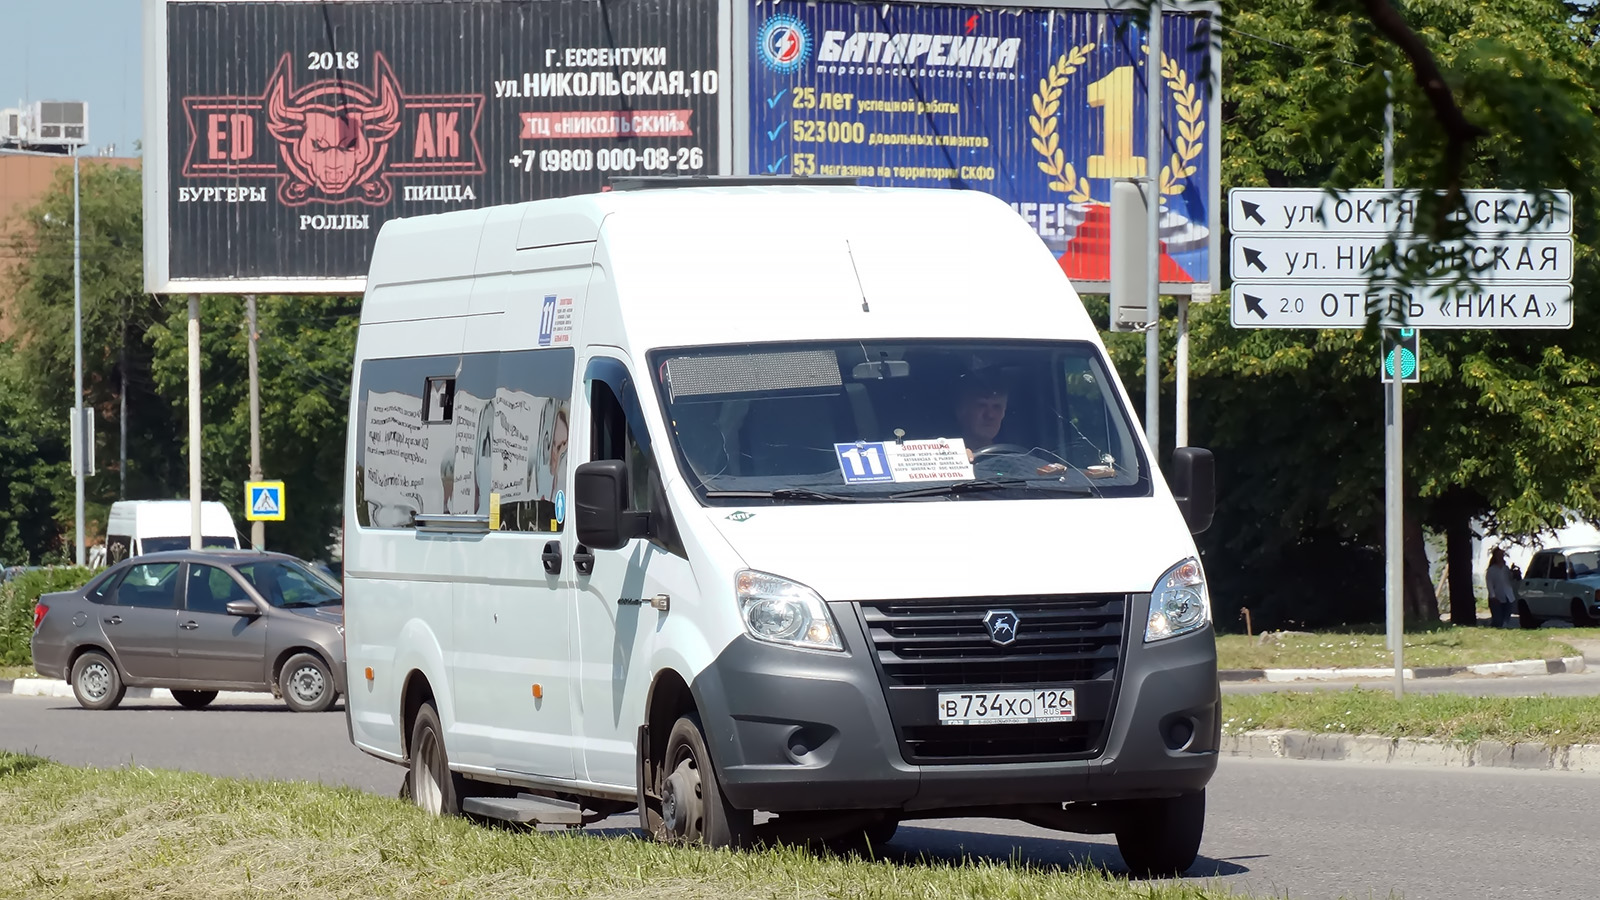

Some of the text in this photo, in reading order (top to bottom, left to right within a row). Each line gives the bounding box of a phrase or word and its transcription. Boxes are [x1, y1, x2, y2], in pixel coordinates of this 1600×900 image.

[308, 52, 360, 70] 2018
[565, 47, 667, 67] ЕССЕНТУКИ
[817, 64, 1016, 80] торгово-сервисная сеть
[792, 87, 959, 115] 25 лет успешной работы
[526, 112, 685, 136] ТЦ «НИКОЛЬСКИЙ»
[793, 120, 989, 148] 523000 довольных клиентов
[1087, 66, 1148, 178] 1
[207, 112, 460, 160] ED AK
[509, 147, 703, 172] +7 (980) 000-08-26
[793, 153, 995, 180] 53 магазина на территории СКФО
[179, 186, 267, 203] БУРГЕРЫ
[403, 185, 477, 204] ПИЦЦА
[299, 214, 370, 230] РОЛЛЫ
[1011, 202, 1065, 236] ЕЕ!
[1283, 199, 1554, 229] ул. ОКТЯЬСКАЯ
[1285, 252, 1326, 275] ул.
[541, 302, 554, 334] 11
[1280, 297, 1304, 313] 2.0
[1439, 294, 1557, 318] «НИКА»
[841, 448, 884, 476] 11
[946, 691, 1069, 718] В734ХО 126
[1043, 708, 1060, 716] RUS
